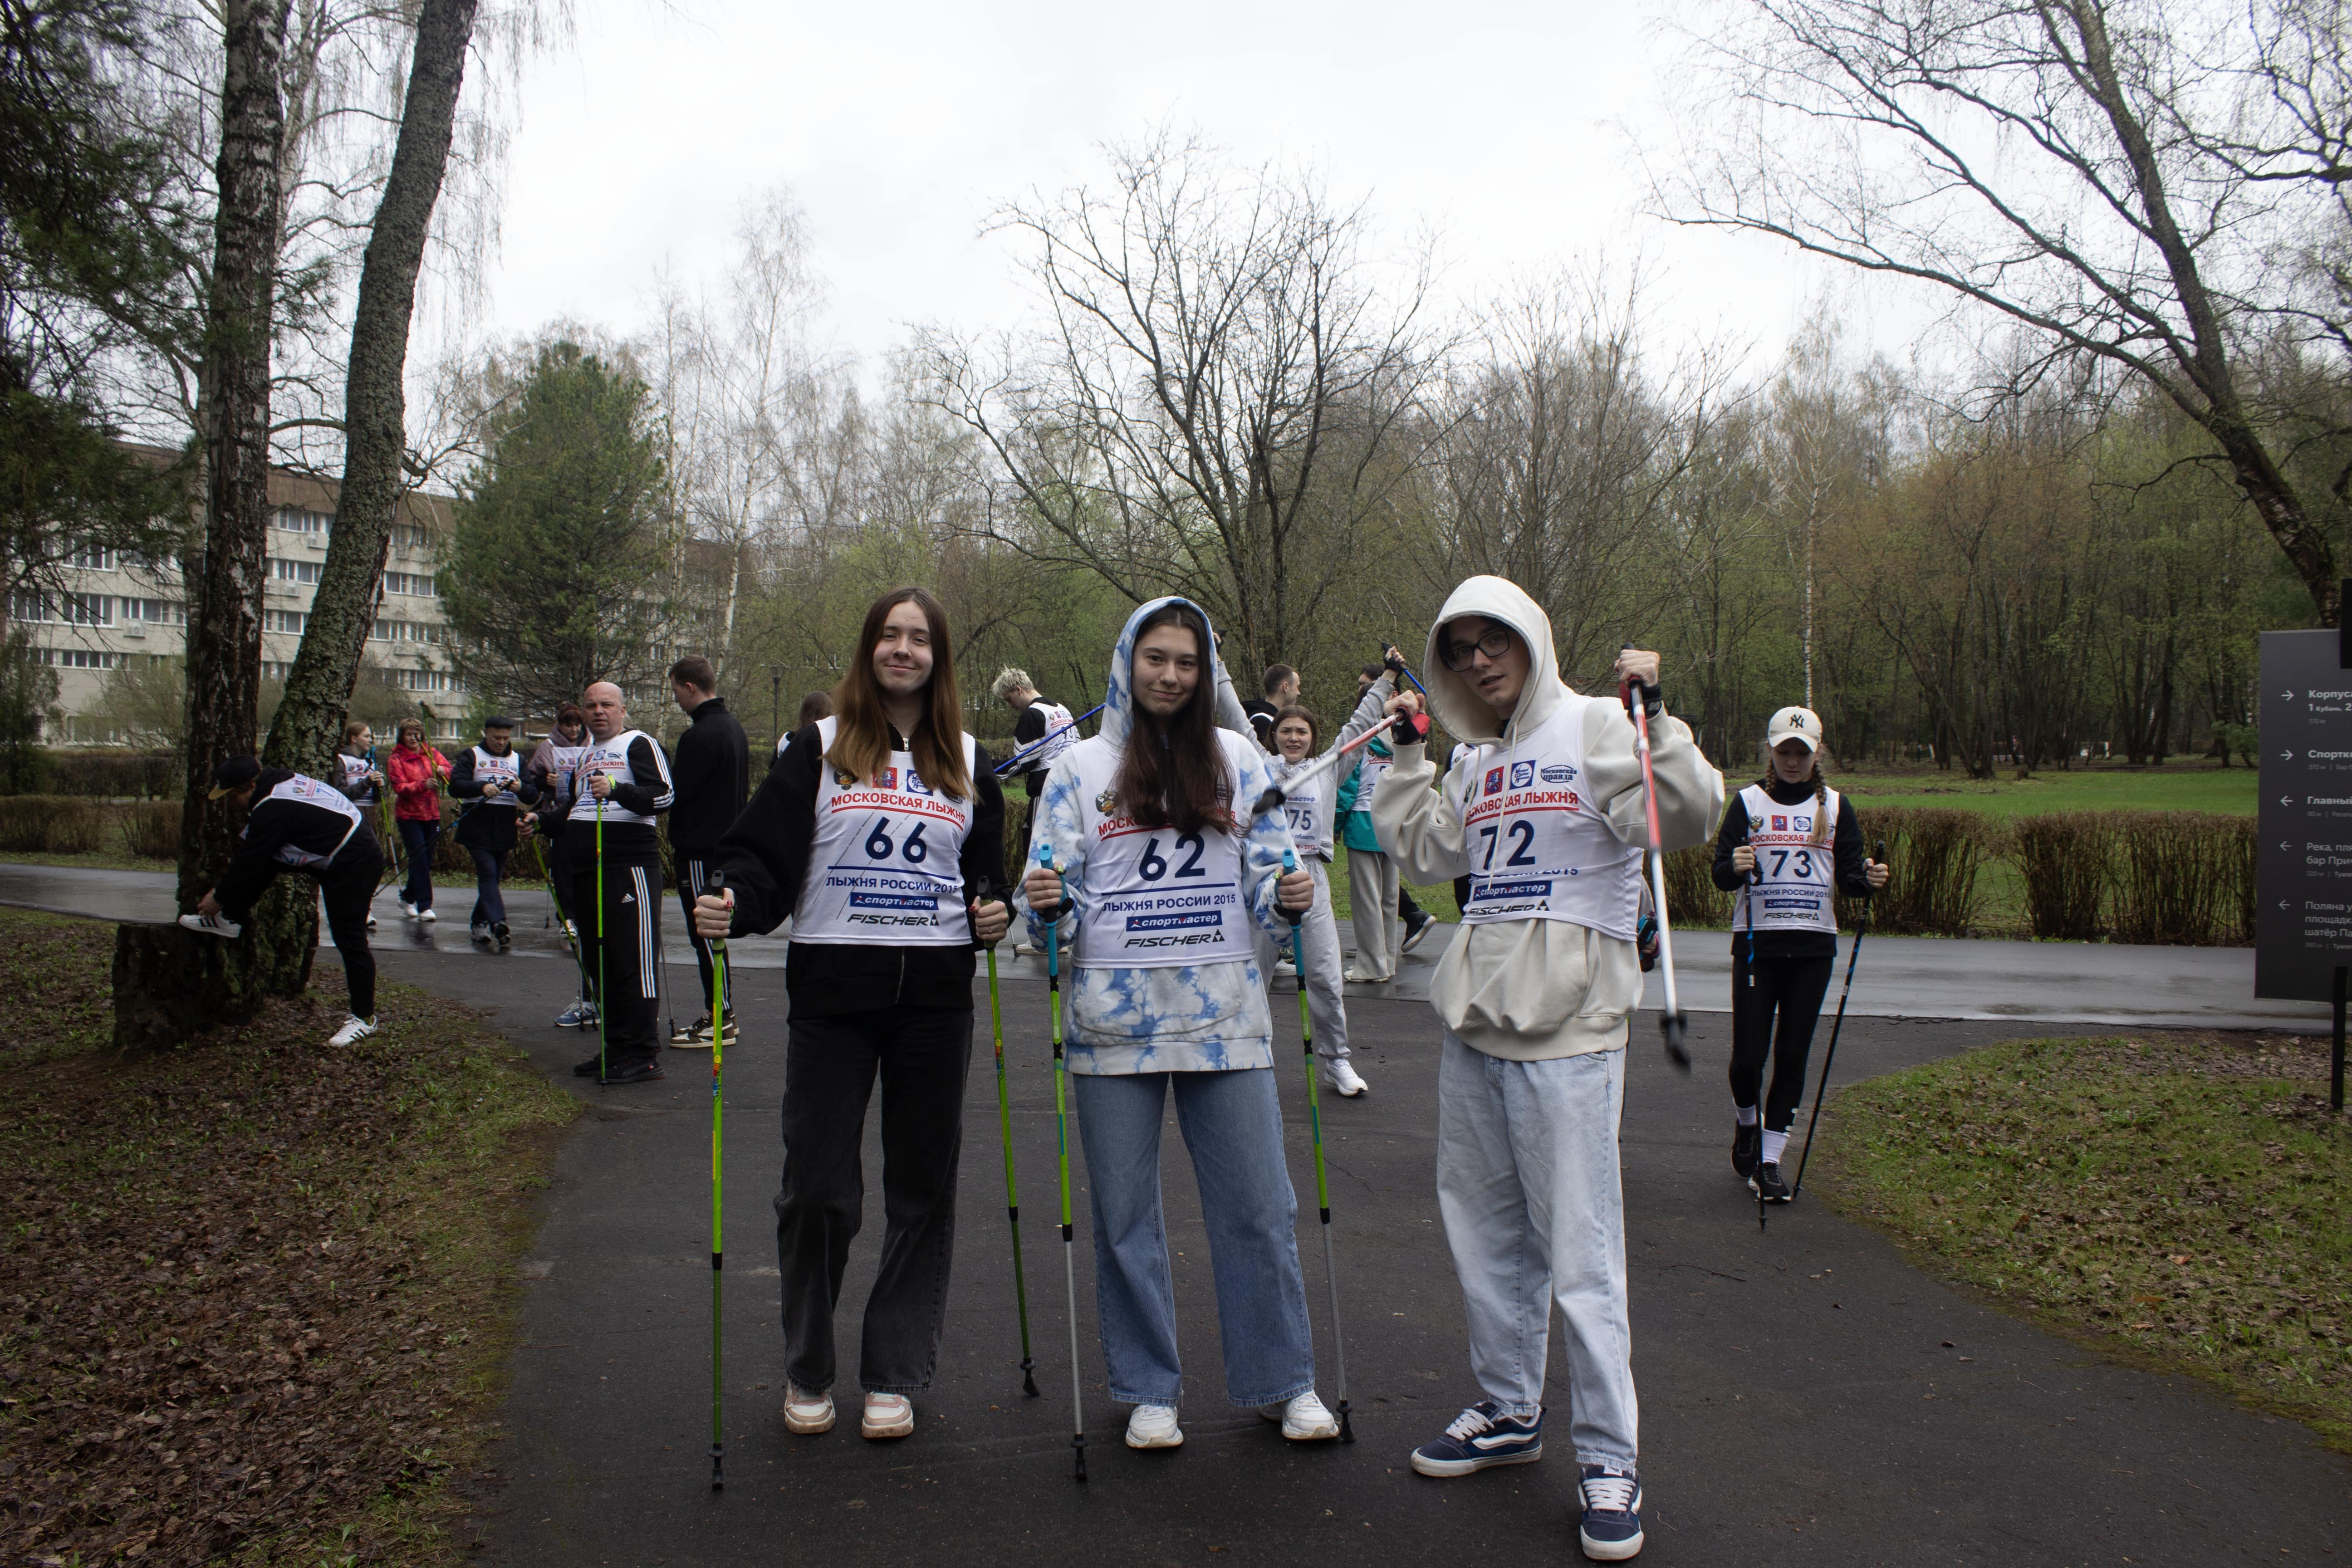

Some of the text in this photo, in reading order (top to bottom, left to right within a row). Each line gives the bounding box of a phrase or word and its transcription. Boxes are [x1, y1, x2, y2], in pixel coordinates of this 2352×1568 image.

[2308, 703, 2314, 711] 1
[1789, 714, 1804, 729] NY
[831, 792, 923, 809] МОСКОВСКАЯ
[926, 800, 965, 825] ЛЫЖНЯ
[1466, 791, 1578, 821] СКОВСКАЯ ЛЫЖНЯ
[865, 816, 927, 864] 66
[1480, 819, 1536, 871] 72
[1749, 834, 1804, 843] МОСКОВСКАЯ
[2307, 842, 2332, 852] Река,
[1138, 833, 1205, 882] 62
[2306, 856, 2326, 866] бар
[1769, 850, 1811, 879] 73
[826, 877, 877, 888] ЛЫЖНЯ
[880, 879, 931, 892] РОССИИ
[1480, 884, 1546, 897] спортмастер
[864, 897, 935, 908] спортмастер
[1102, 894, 1236, 911] ЛЫЖНЯ РОССИИ 2015
[2305, 901, 2345, 910] Поляна
[847, 914, 929, 926] FISCHER
[1142, 914, 1218, 927] спортмастер
[2304, 928, 2337, 939] шатёр
[1124, 934, 1212, 948] FISCHER
